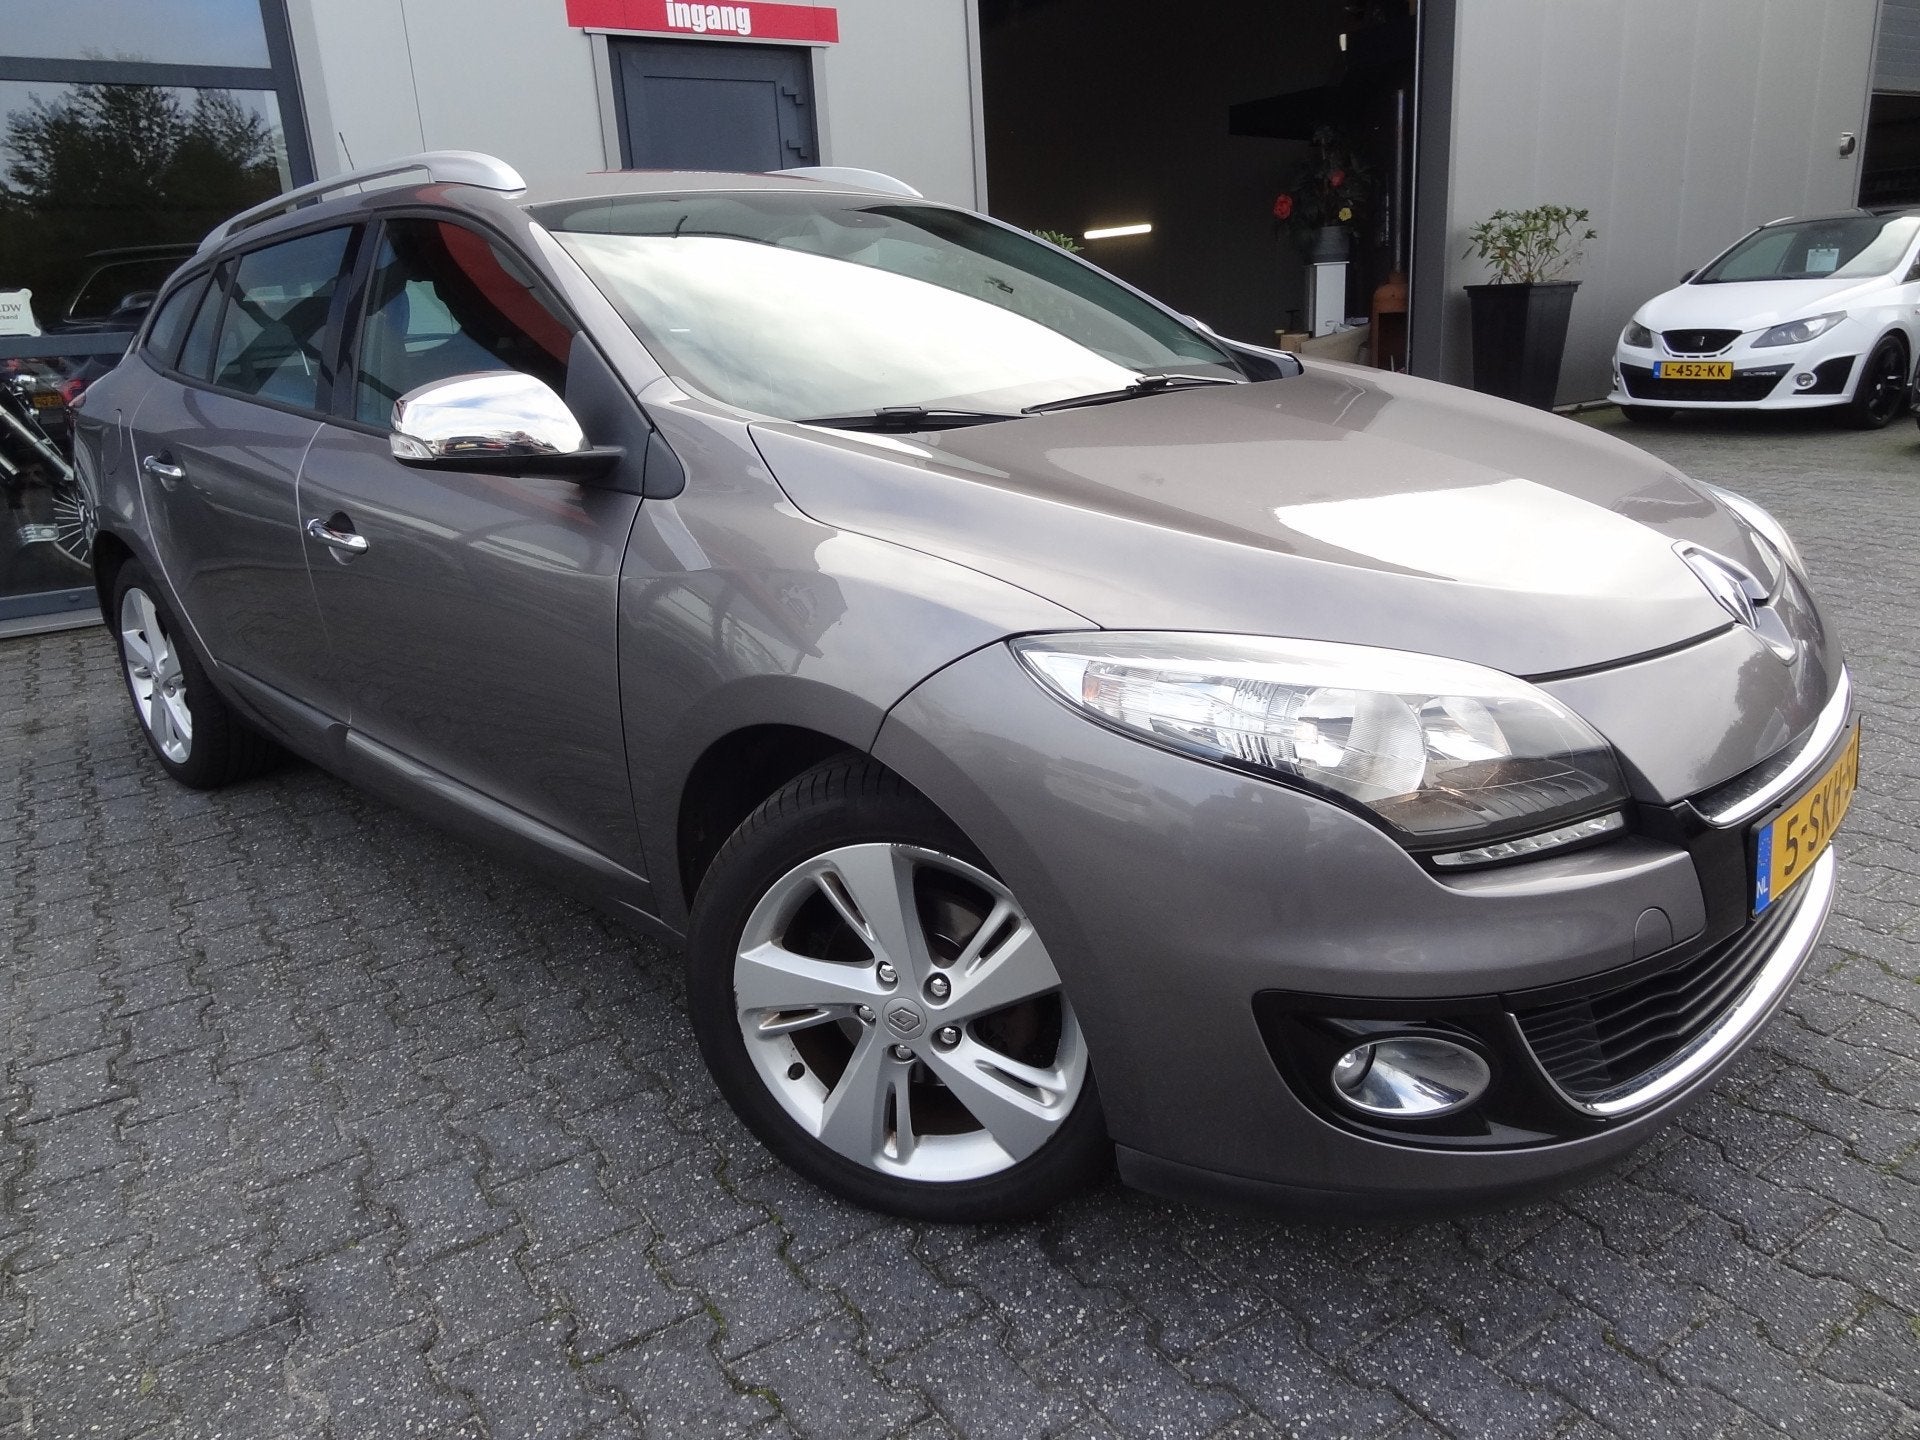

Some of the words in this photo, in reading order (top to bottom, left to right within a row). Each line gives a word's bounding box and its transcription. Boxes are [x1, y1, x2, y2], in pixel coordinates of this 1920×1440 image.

[665, 0, 752, 35] ingang
[0, 303, 22, 312] DW
[1664, 364, 1726, 377] L-452-KK
[1756, 878, 1769, 899] NL
